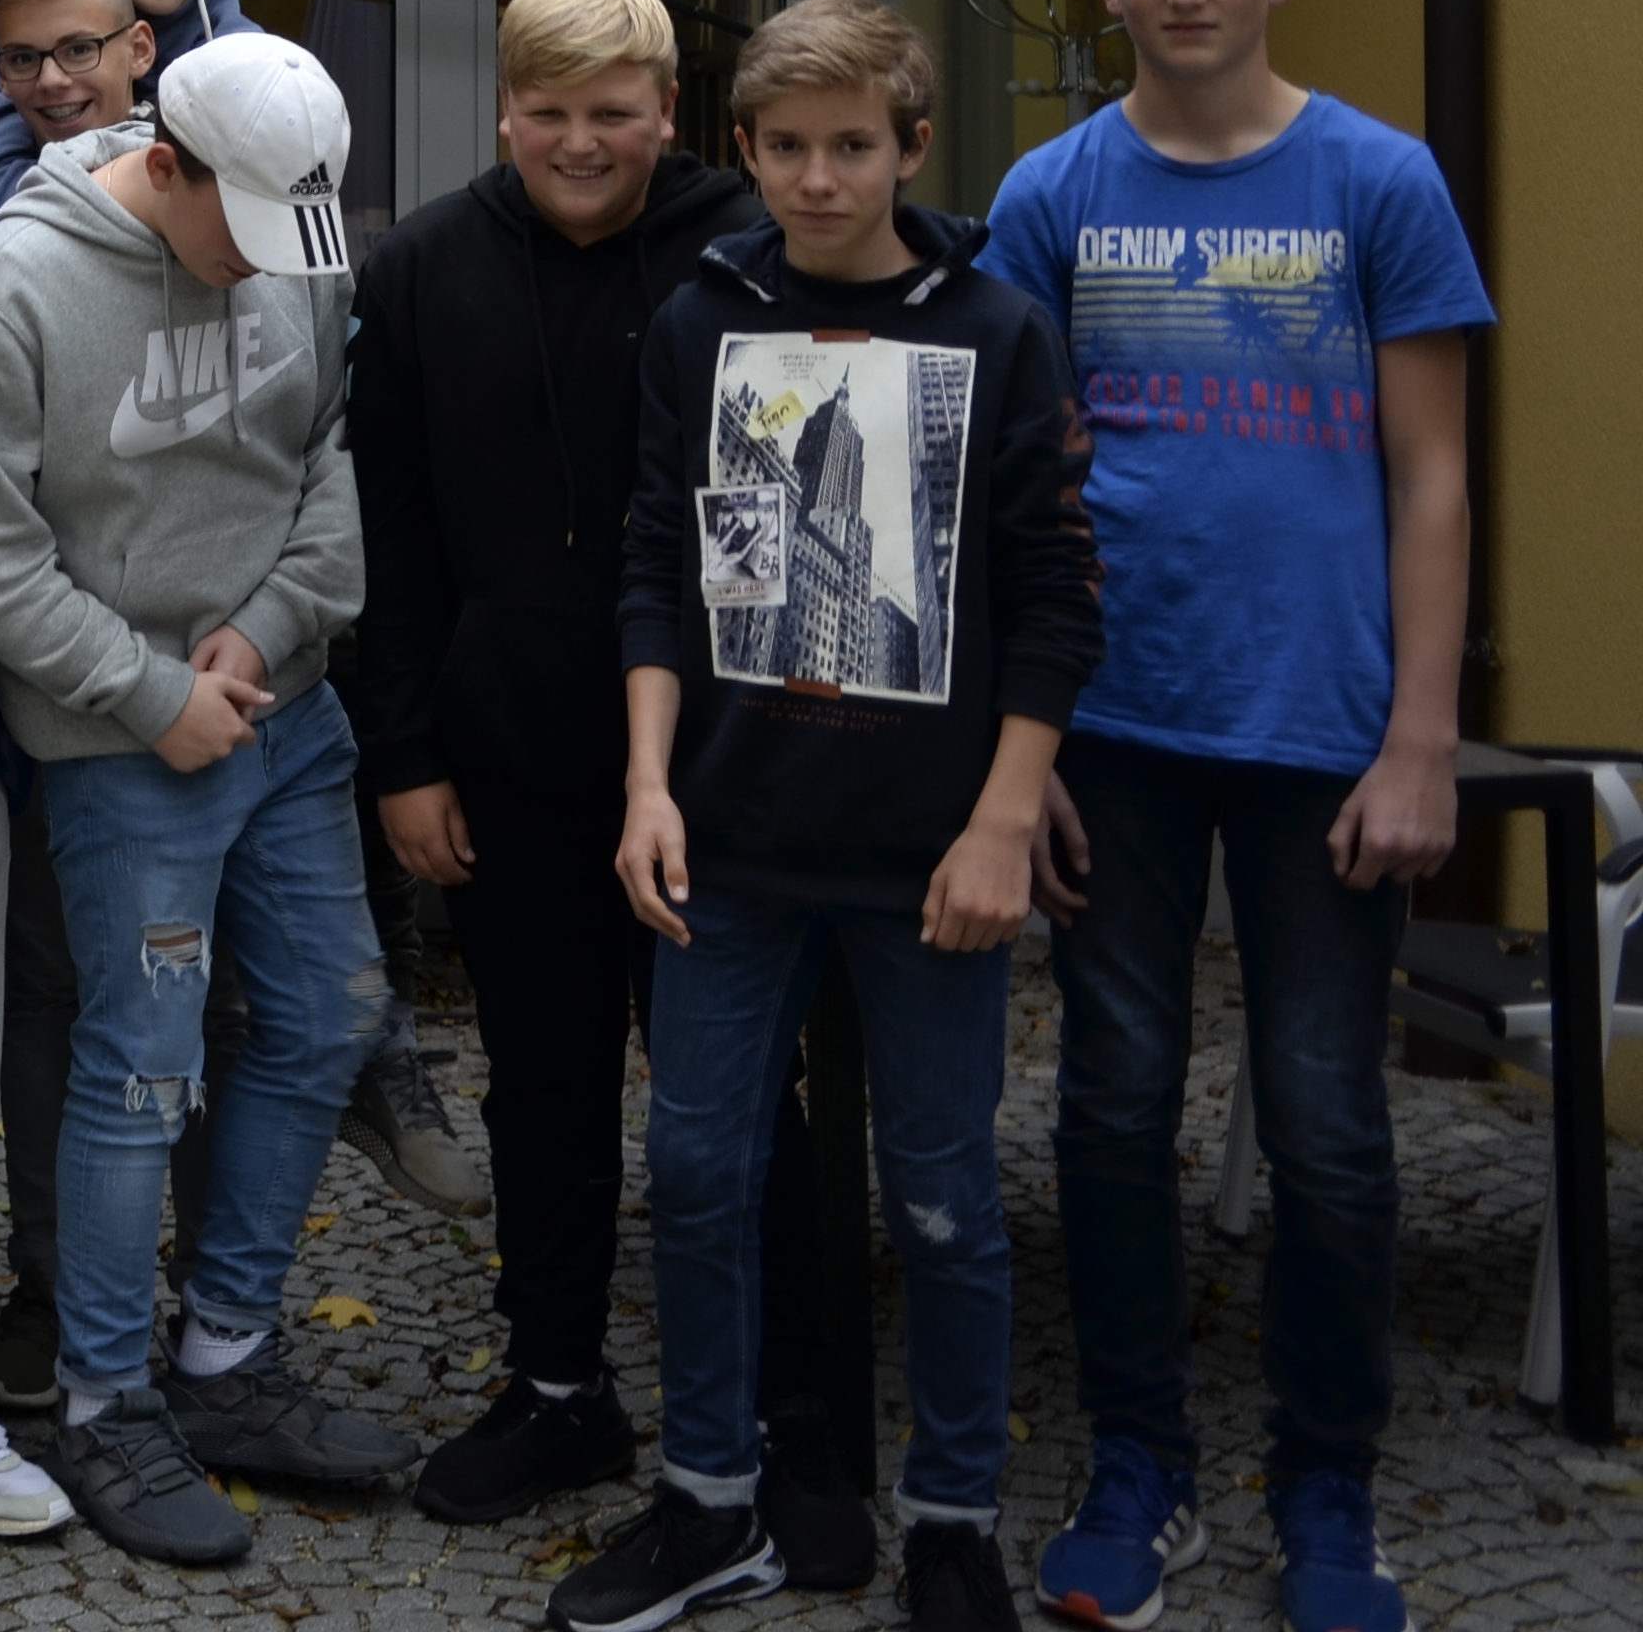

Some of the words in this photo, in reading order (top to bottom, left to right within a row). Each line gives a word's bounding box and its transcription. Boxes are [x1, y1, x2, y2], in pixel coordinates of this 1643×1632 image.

[289, 182, 333, 196] adidas
[1078, 226, 1186, 268] DENIM
[1195, 228, 1346, 272] SURFING
[140, 311, 264, 404] NIKE
[1202, 375, 1313, 418] DENIM
